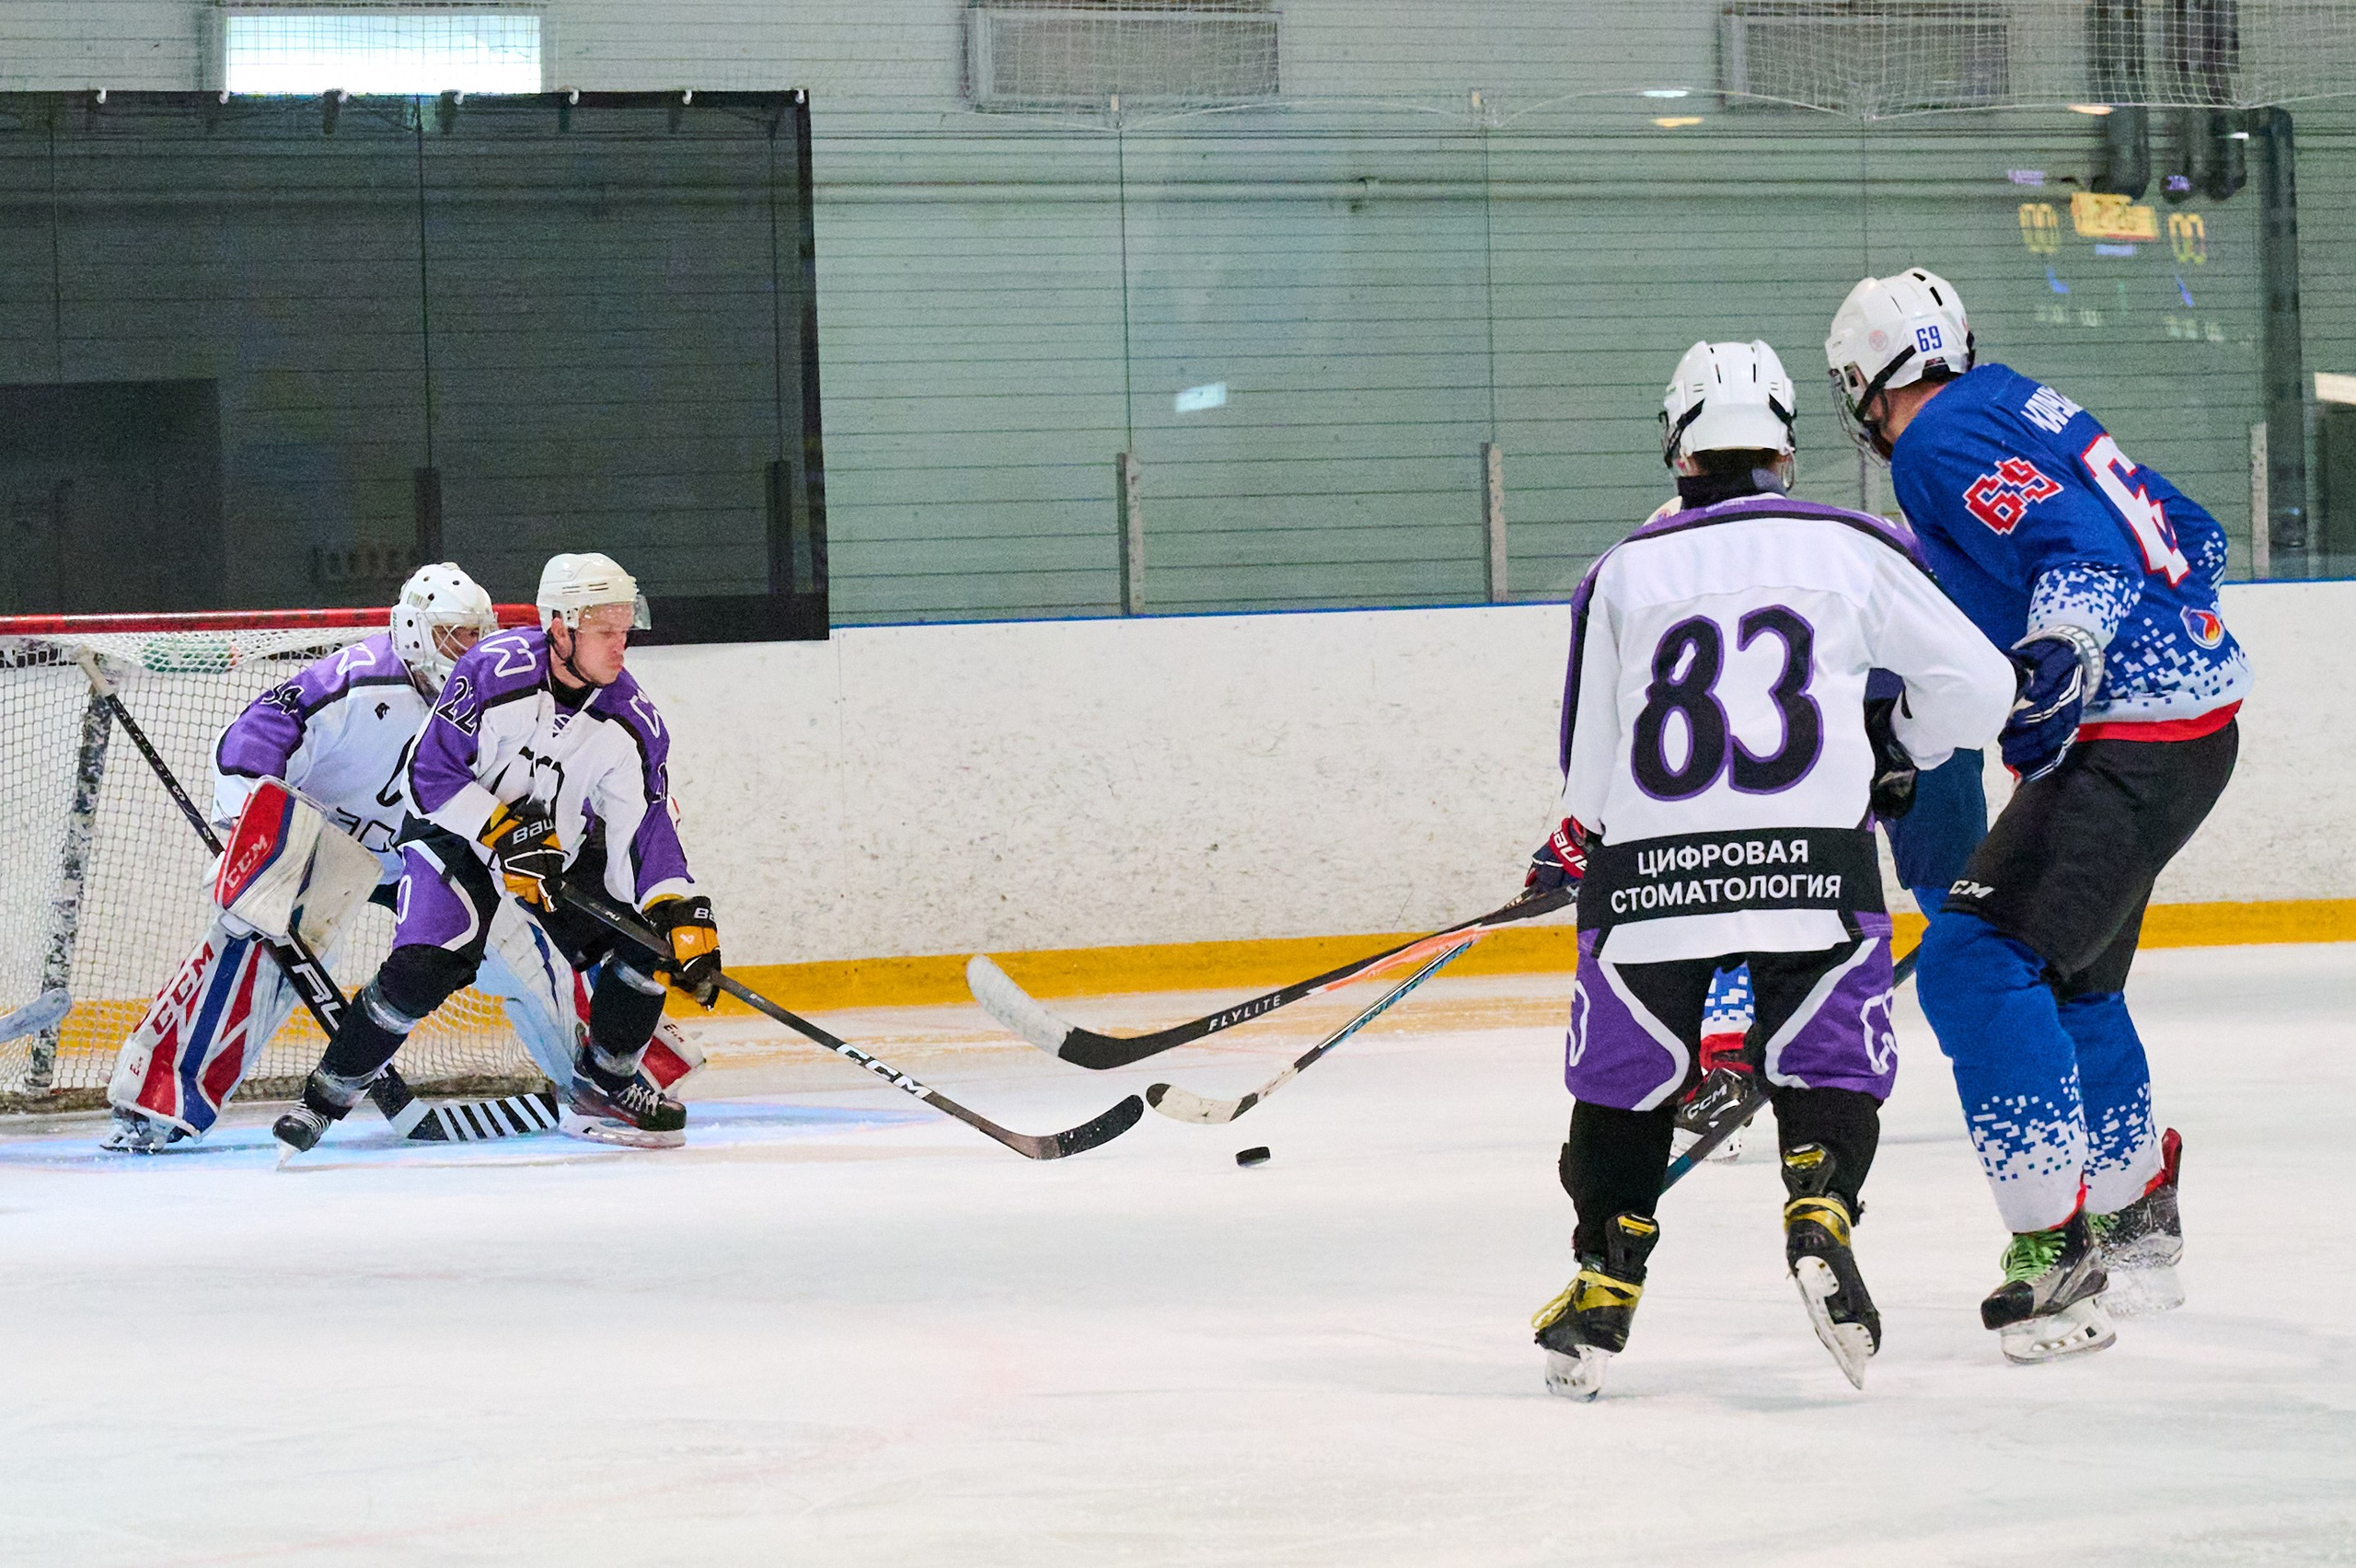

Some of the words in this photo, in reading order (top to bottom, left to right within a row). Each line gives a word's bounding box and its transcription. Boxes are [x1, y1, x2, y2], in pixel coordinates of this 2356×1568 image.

[1915, 325, 1943, 352] 69
[1961, 455, 2064, 536] 69
[1630, 604, 1824, 802] 83
[225, 834, 268, 889] CCM
[1637, 839, 1808, 878] ЦИФРОВАЯ
[1610, 874, 1842, 914] СТОМАТОЛОГИЯ
[151, 940, 215, 1035] CCM
[1208, 995, 1281, 1032] FLYLITE
[836, 1043, 933, 1100] CCM
[1687, 1083, 1727, 1120] CCM
